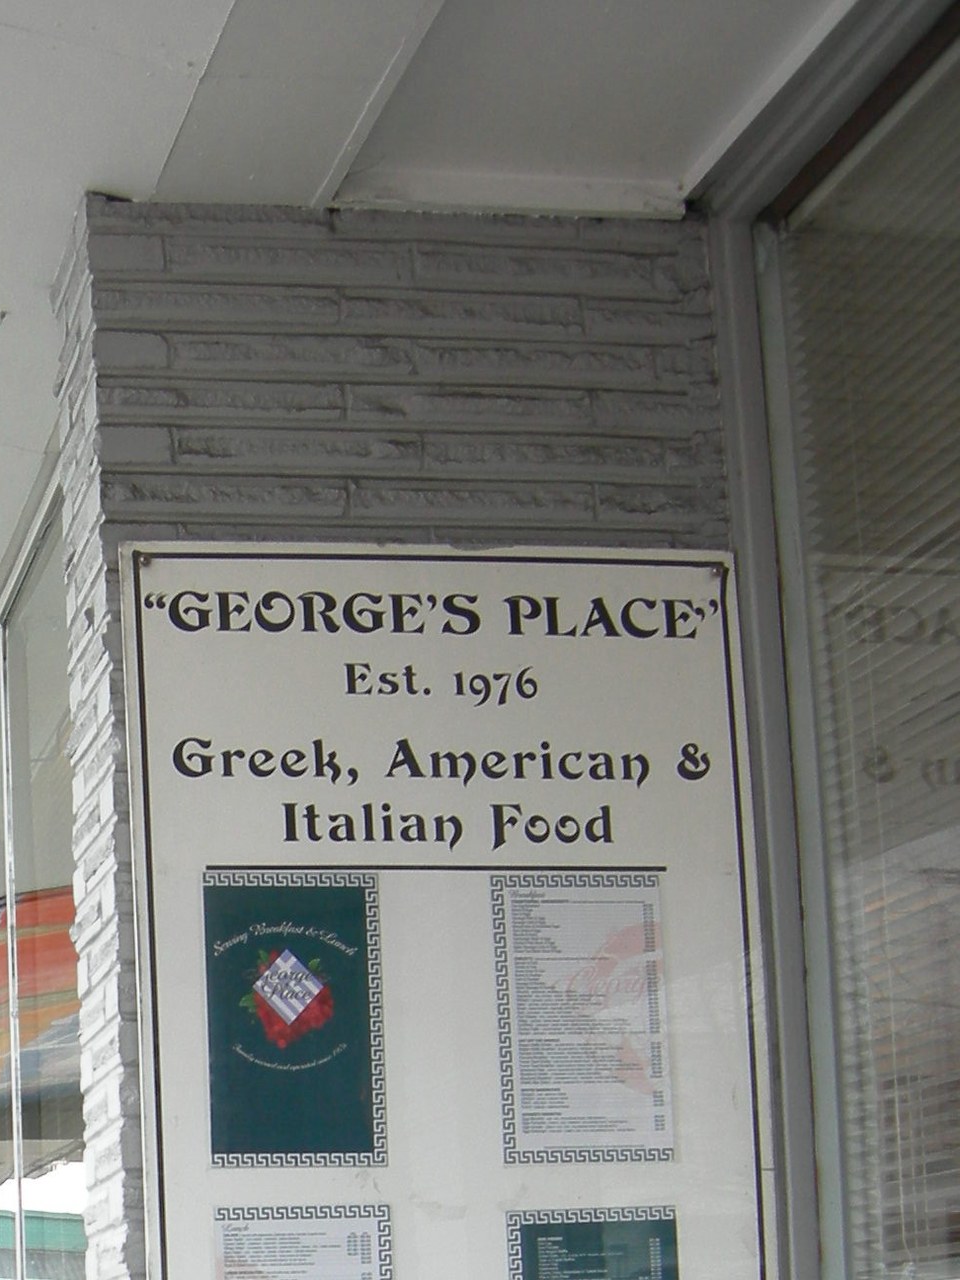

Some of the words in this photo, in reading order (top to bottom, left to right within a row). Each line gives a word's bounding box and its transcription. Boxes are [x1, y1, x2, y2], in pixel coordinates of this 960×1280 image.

[343, 662, 432, 697] Est.
[454, 666, 538, 707] 1976
[172, 737, 359, 787] Greek,
[385, 737, 650, 789] American
[676, 743, 711, 781] &
[281, 801, 463, 850] Italian
[490, 802, 615, 851] Food
[249, 921, 305, 937] Breakfast
[319, 930, 359, 956] Lunch
